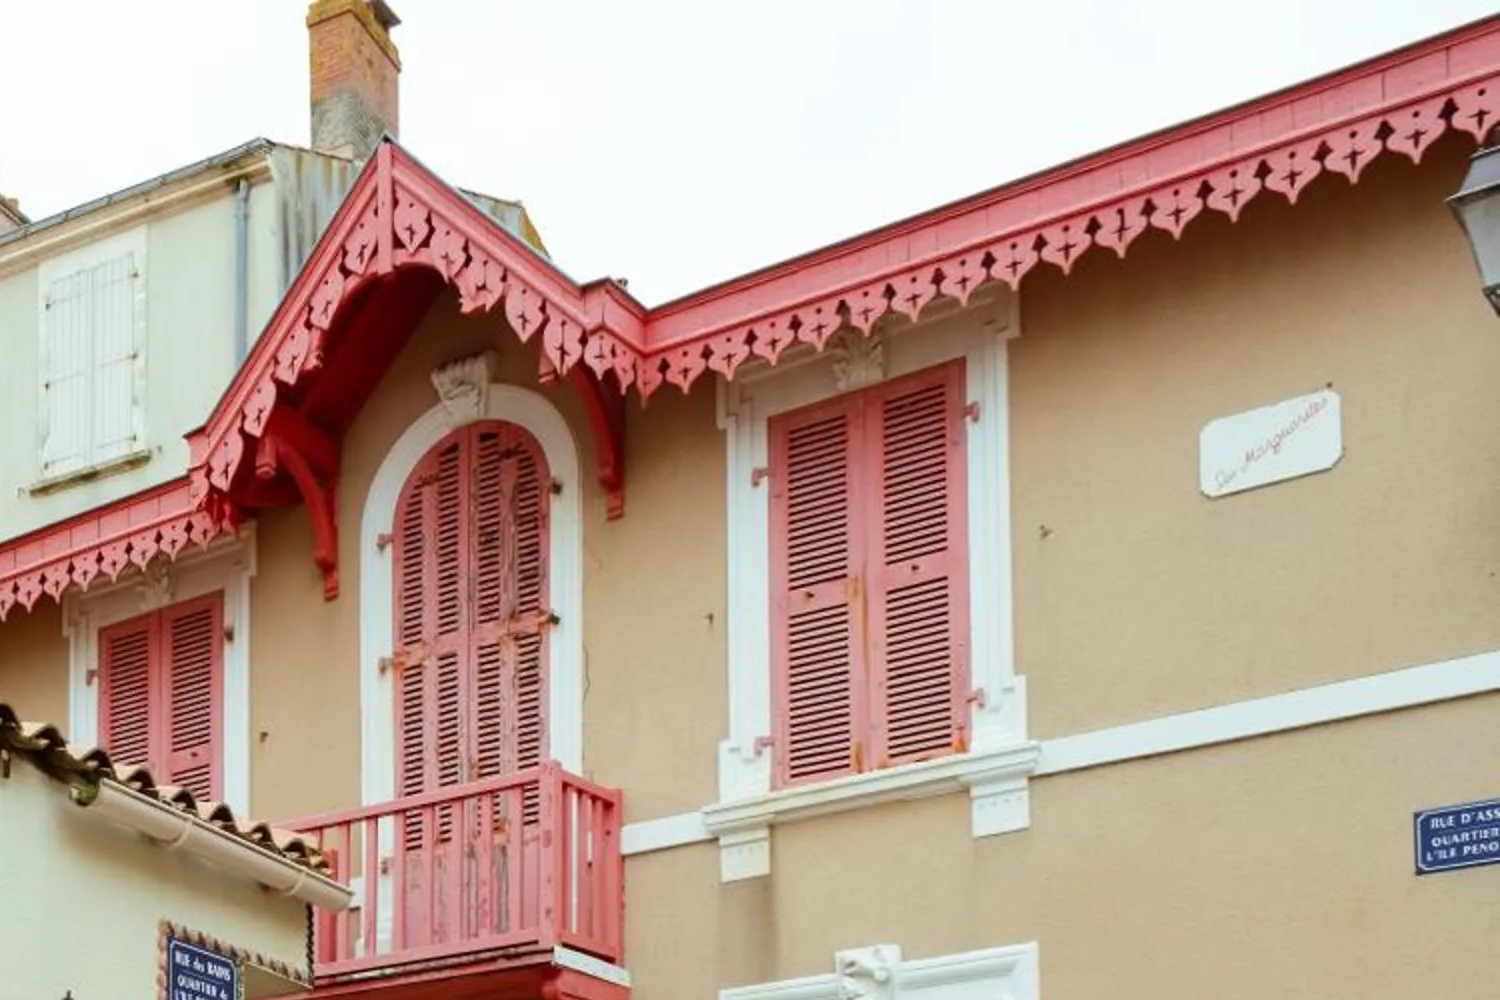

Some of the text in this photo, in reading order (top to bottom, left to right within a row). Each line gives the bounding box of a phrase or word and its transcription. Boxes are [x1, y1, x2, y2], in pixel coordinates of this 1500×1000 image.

[1431, 815, 1454, 829] RUE
[1431, 827, 1499, 847] QUARTIER
[1463, 841, 1499, 856] PENO
[175, 951, 190, 967] RUE
[177, 975, 217, 997] QUARTIER
